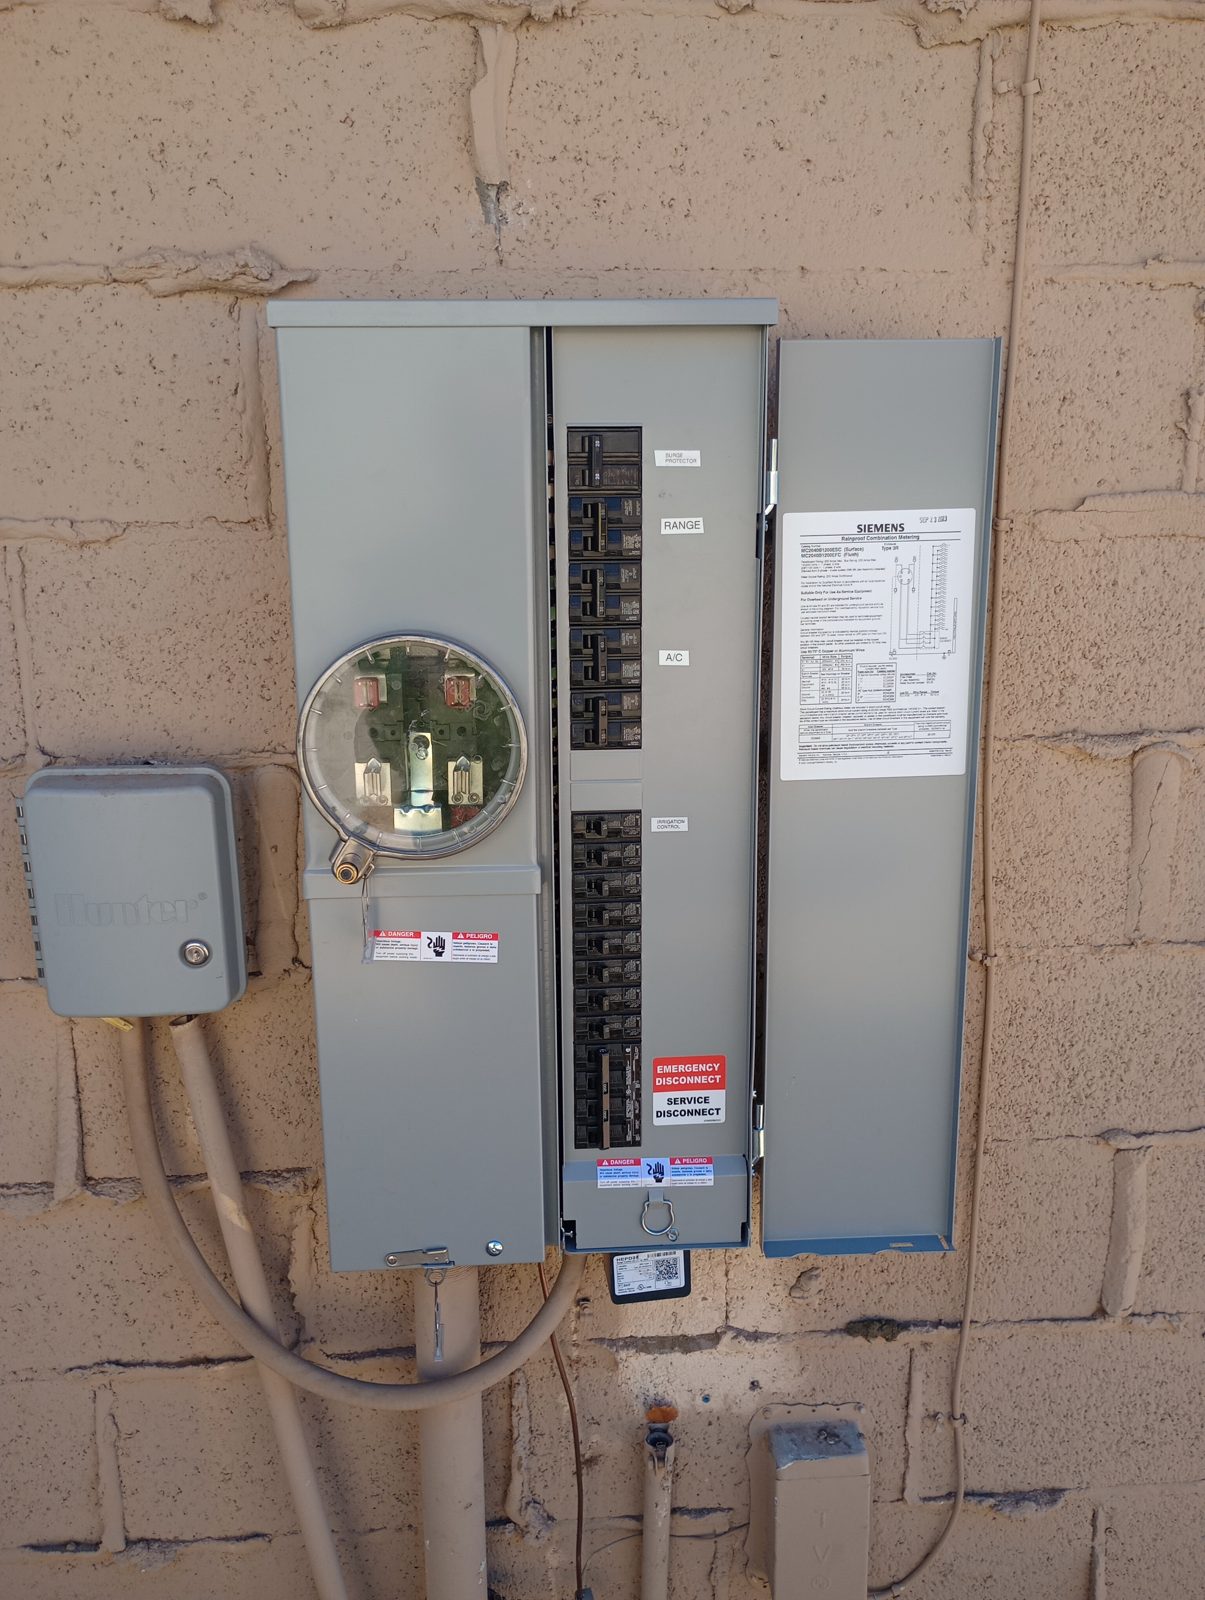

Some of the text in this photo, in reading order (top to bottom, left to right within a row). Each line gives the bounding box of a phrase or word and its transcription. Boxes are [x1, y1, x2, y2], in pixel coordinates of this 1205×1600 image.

[664, 520, 701, 530] RANGE
[856, 523, 905, 533] SIEMENS
[665, 653, 683, 662] A/C
[656, 1063, 720, 1074] EMERGENCY
[655, 1075, 722, 1086] DISCONNECT
[666, 1096, 710, 1106] SERVICE
[655, 1107, 722, 1118] DISCONNECT
